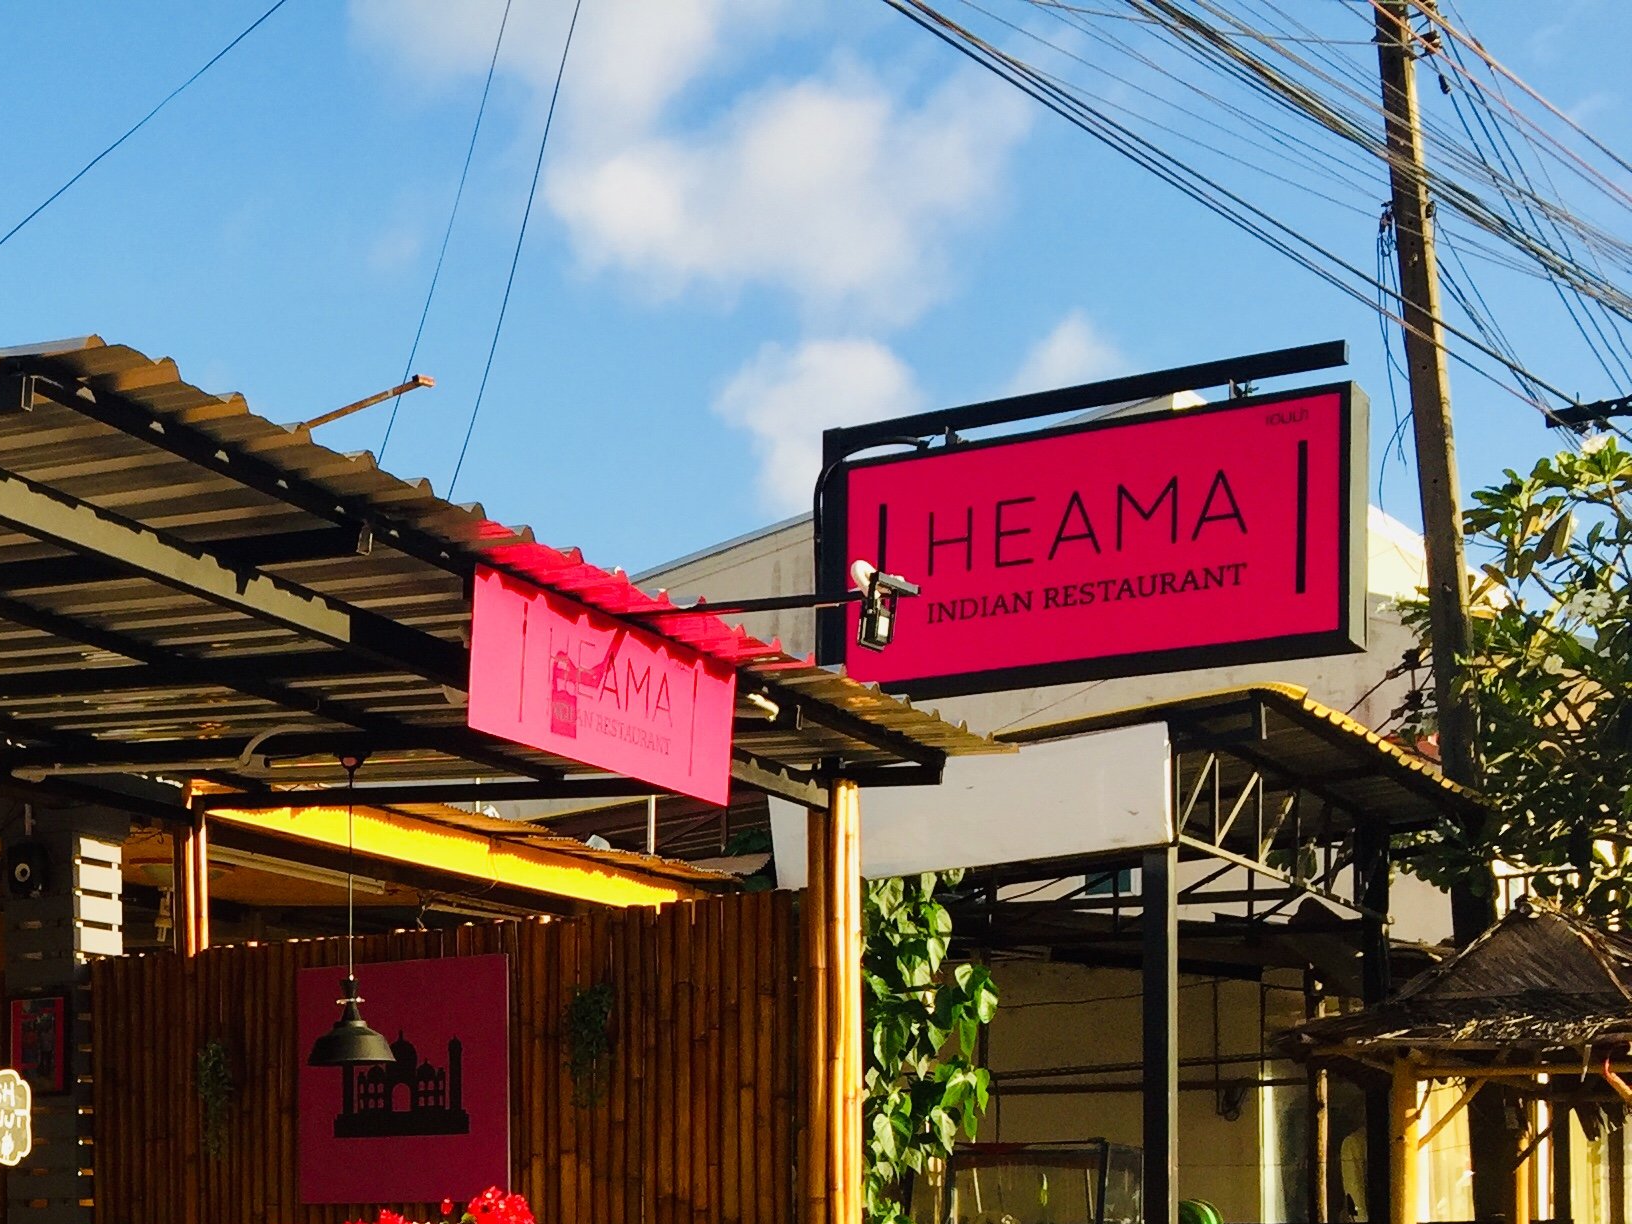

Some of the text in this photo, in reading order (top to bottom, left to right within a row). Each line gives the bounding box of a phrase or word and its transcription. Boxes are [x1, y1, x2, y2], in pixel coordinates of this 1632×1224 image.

[927, 468, 1248, 577] HEAMA
[926, 562, 1249, 624] INDIAN RESTAURANT
[548, 627, 673, 728] HEAMA
[596, 714, 672, 756] RESTAURANT
